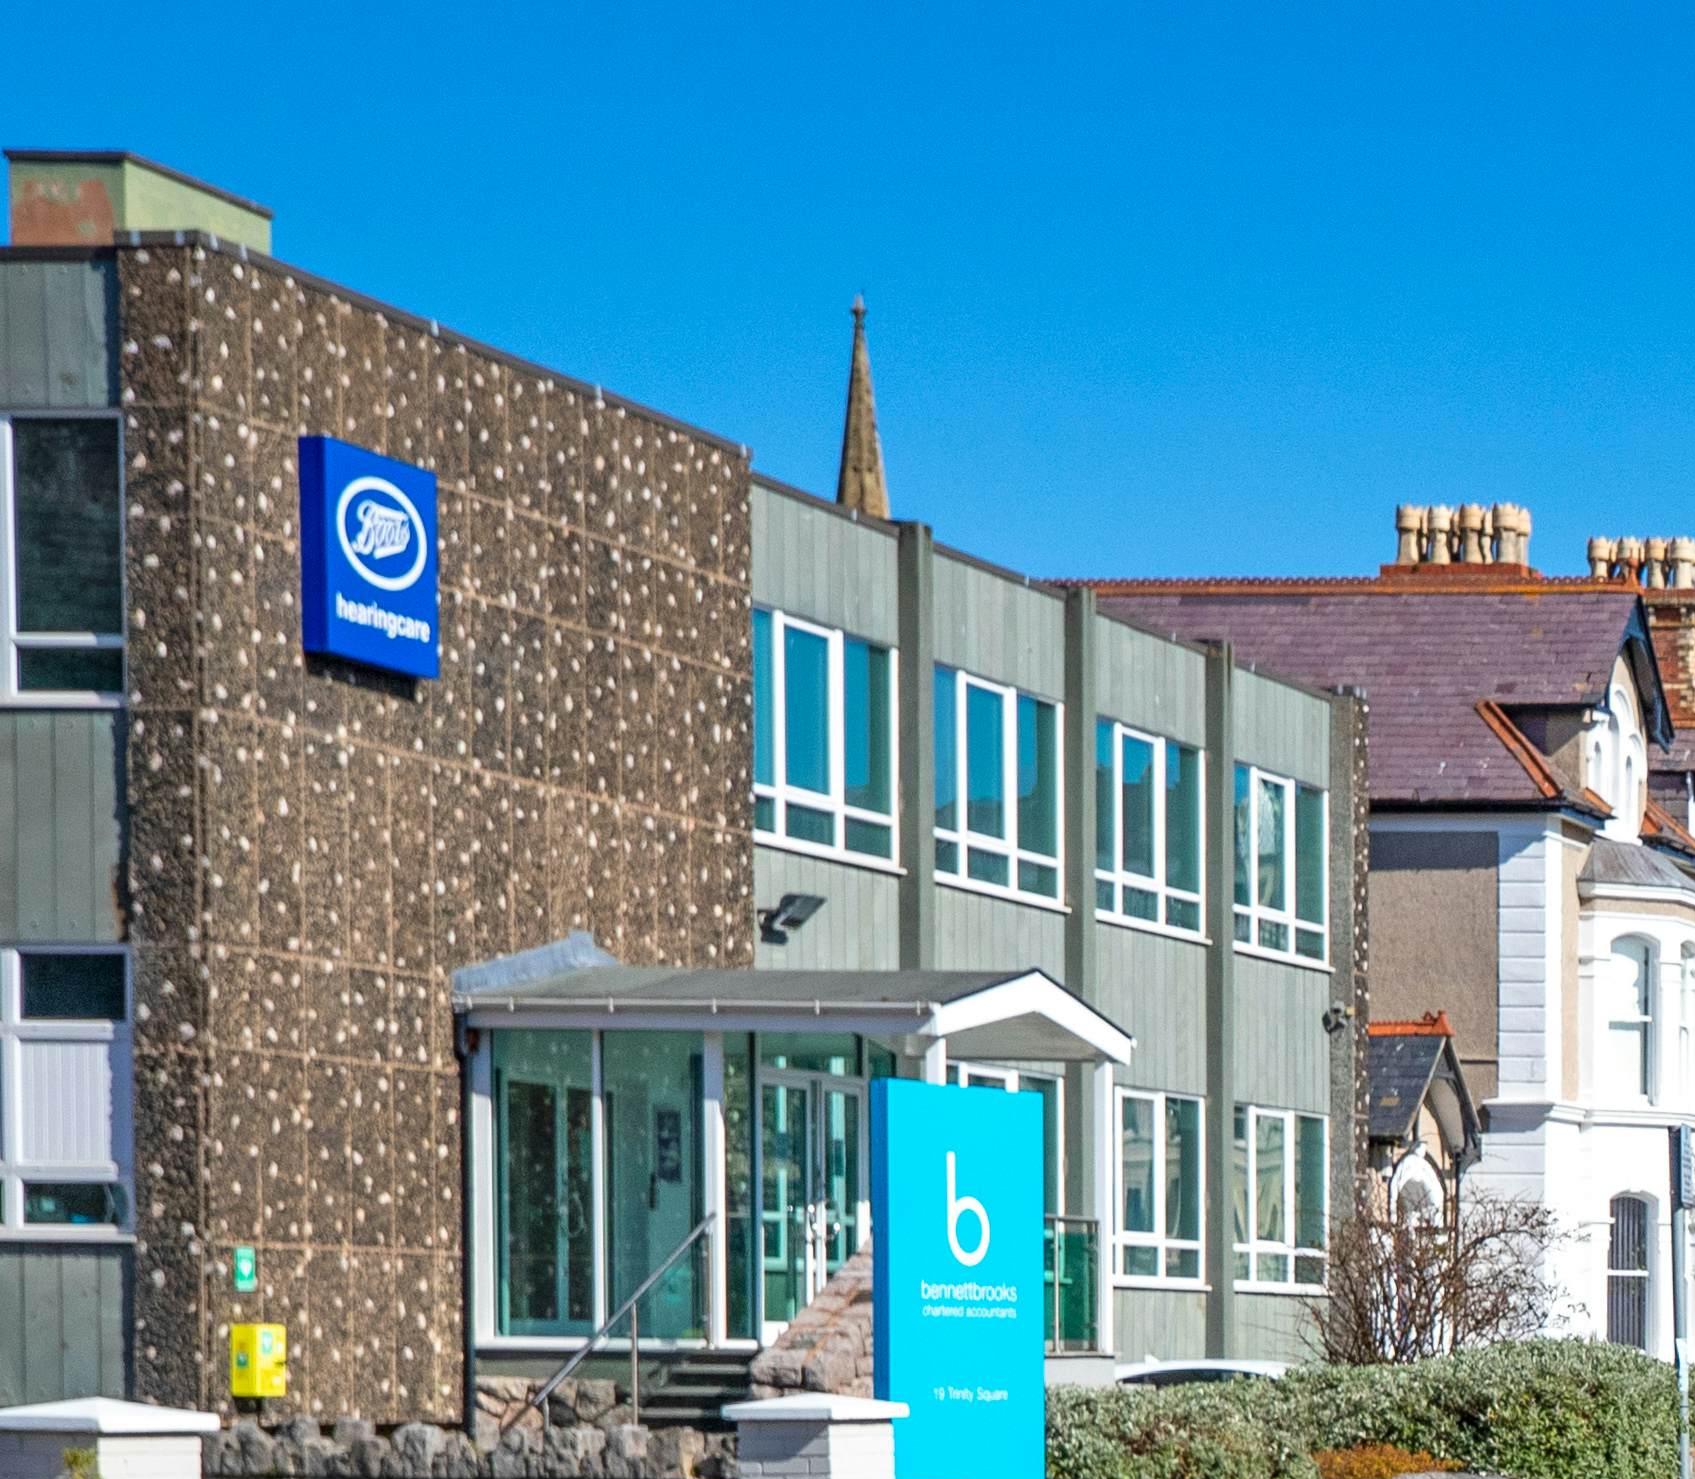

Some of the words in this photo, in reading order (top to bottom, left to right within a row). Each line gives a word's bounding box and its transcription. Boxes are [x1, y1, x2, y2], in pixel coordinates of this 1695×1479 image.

[351, 499, 410, 560] Boots
[335, 592, 430, 643] hearingcare
[946, 1151, 991, 1267] b
[921, 1280, 1017, 1303] bennettbrooks
[922, 1304, 964, 1318] chartered
[966, 1306, 1017, 1319] accountants
[934, 1387, 945, 1401] 19
[948, 1387, 974, 1402] Trinity
[977, 1386, 1008, 1402] Square
